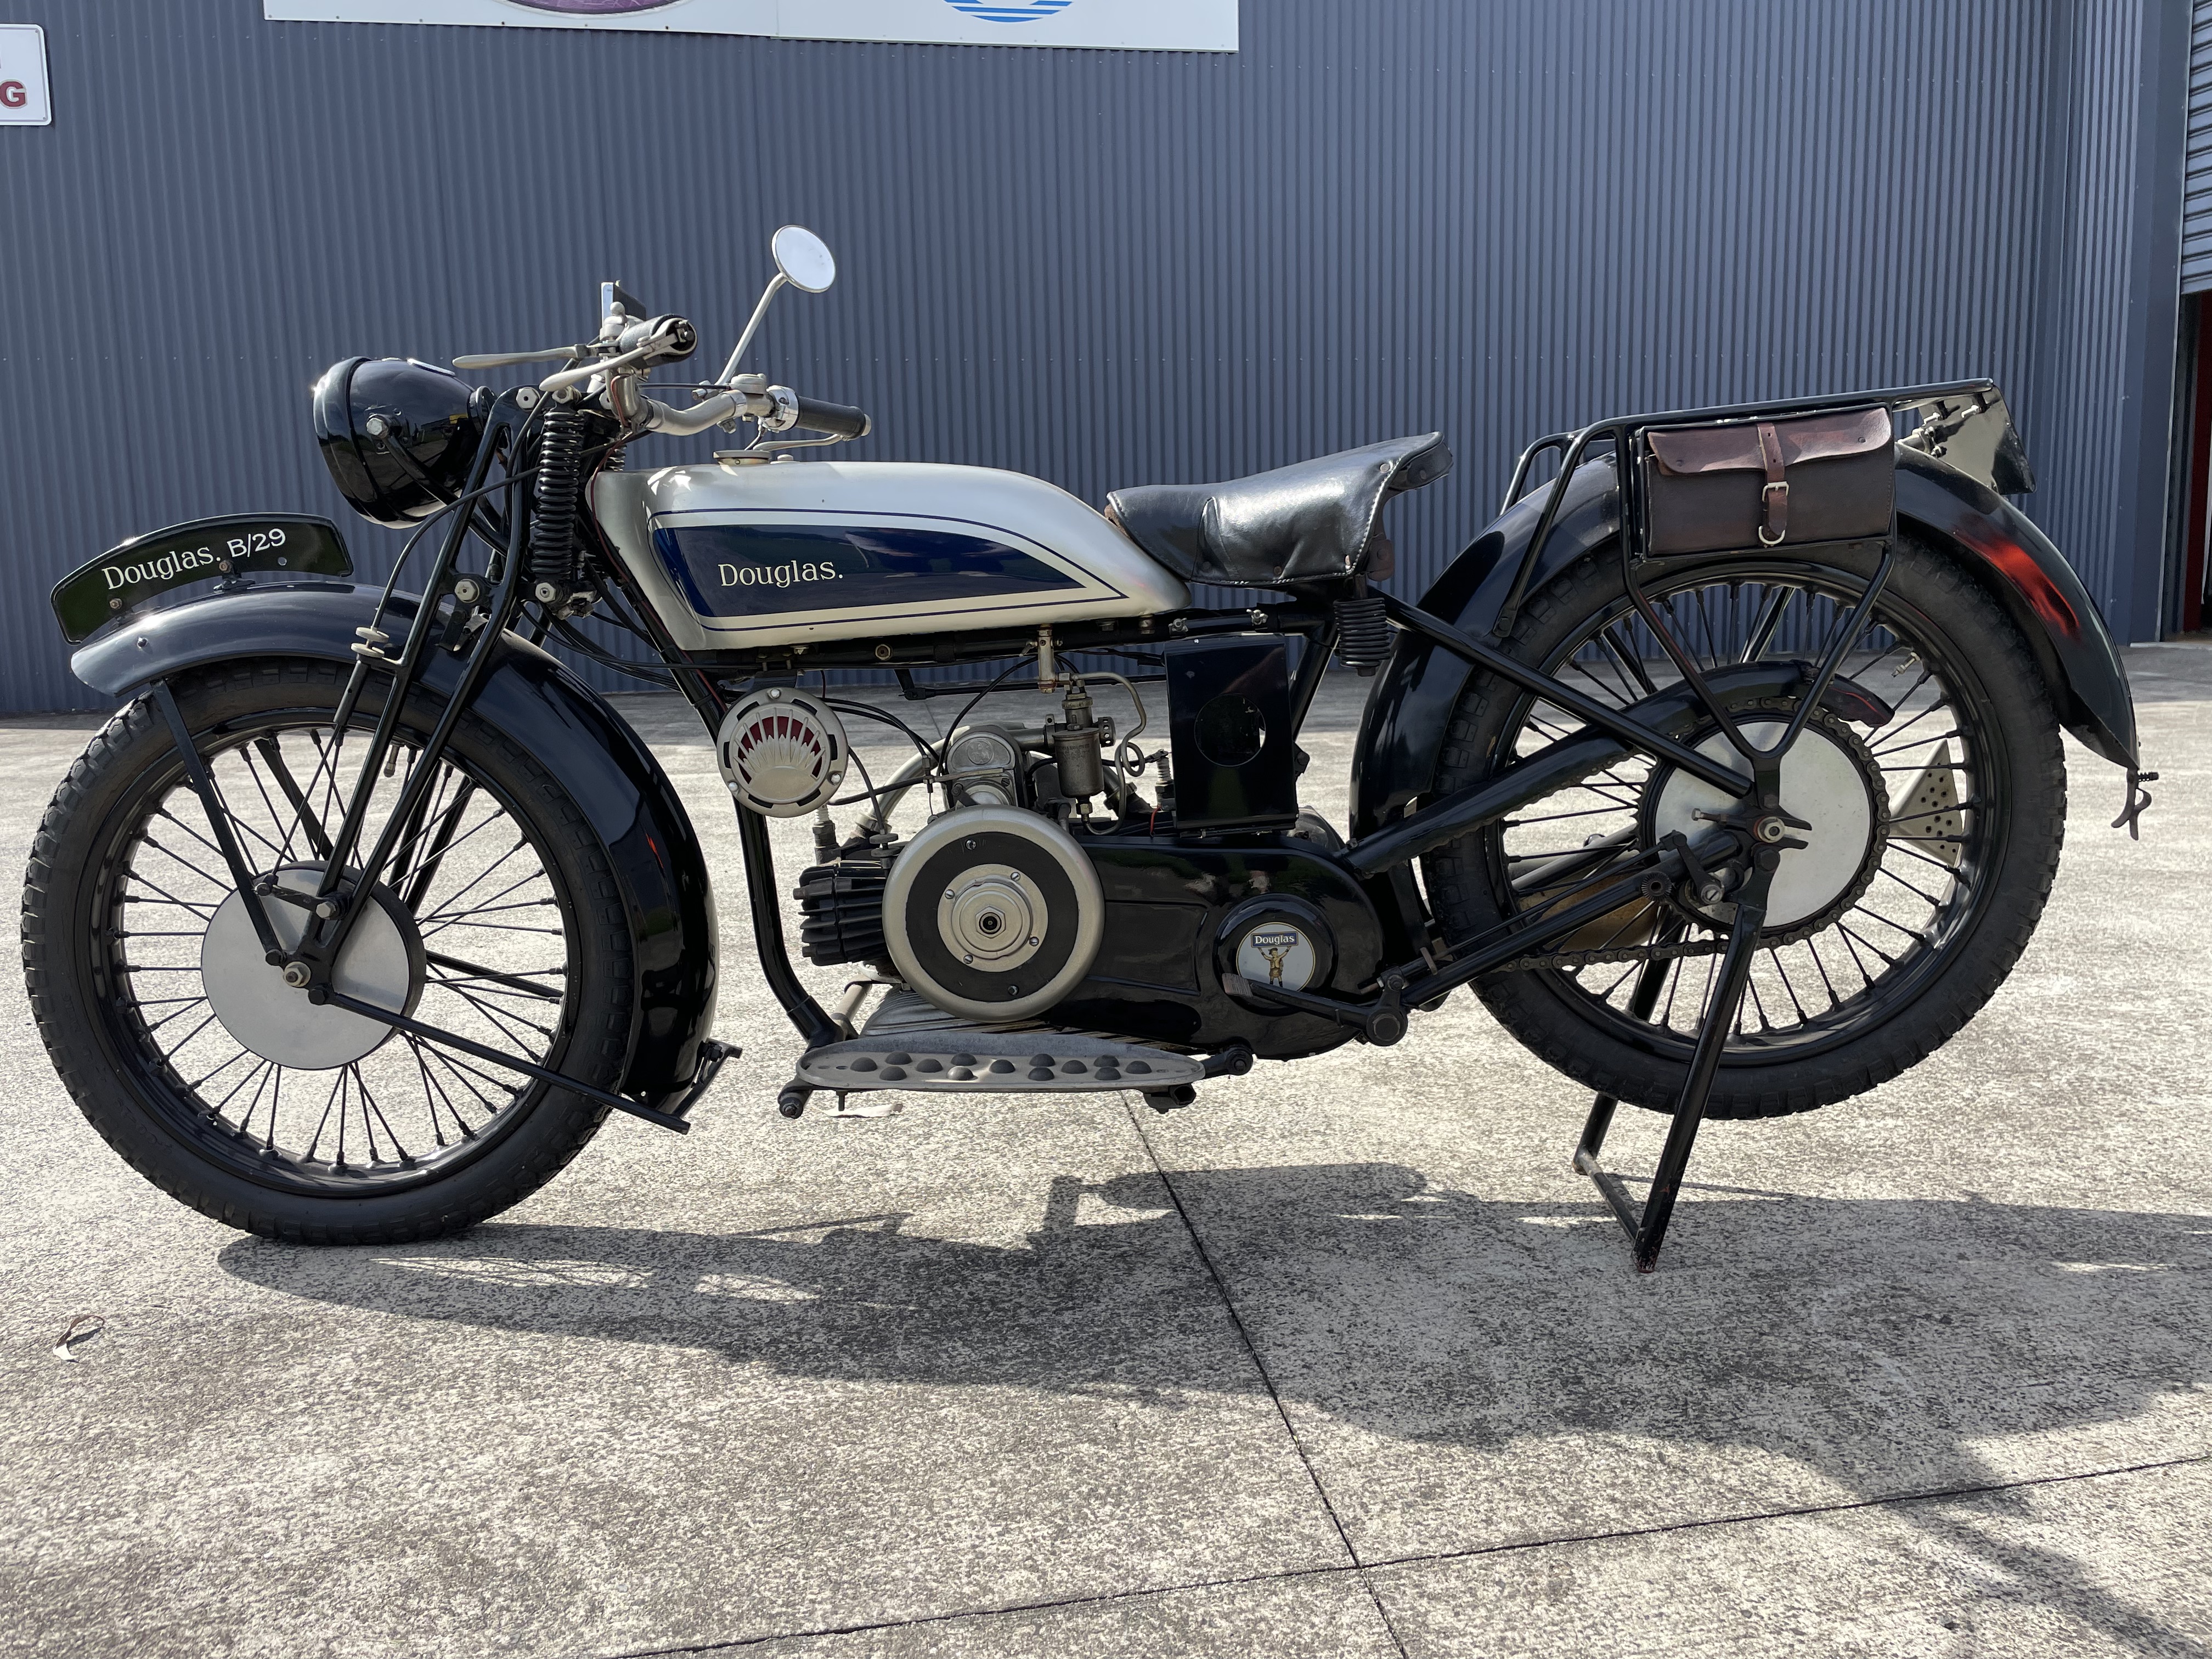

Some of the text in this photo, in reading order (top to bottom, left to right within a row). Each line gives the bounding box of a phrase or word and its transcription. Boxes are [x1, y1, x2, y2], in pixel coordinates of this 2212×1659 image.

[101, 528, 286, 590] Douglas. B/29
[718, 560, 843, 588] Douglas.
[1254, 934, 1295, 945] Douglas
